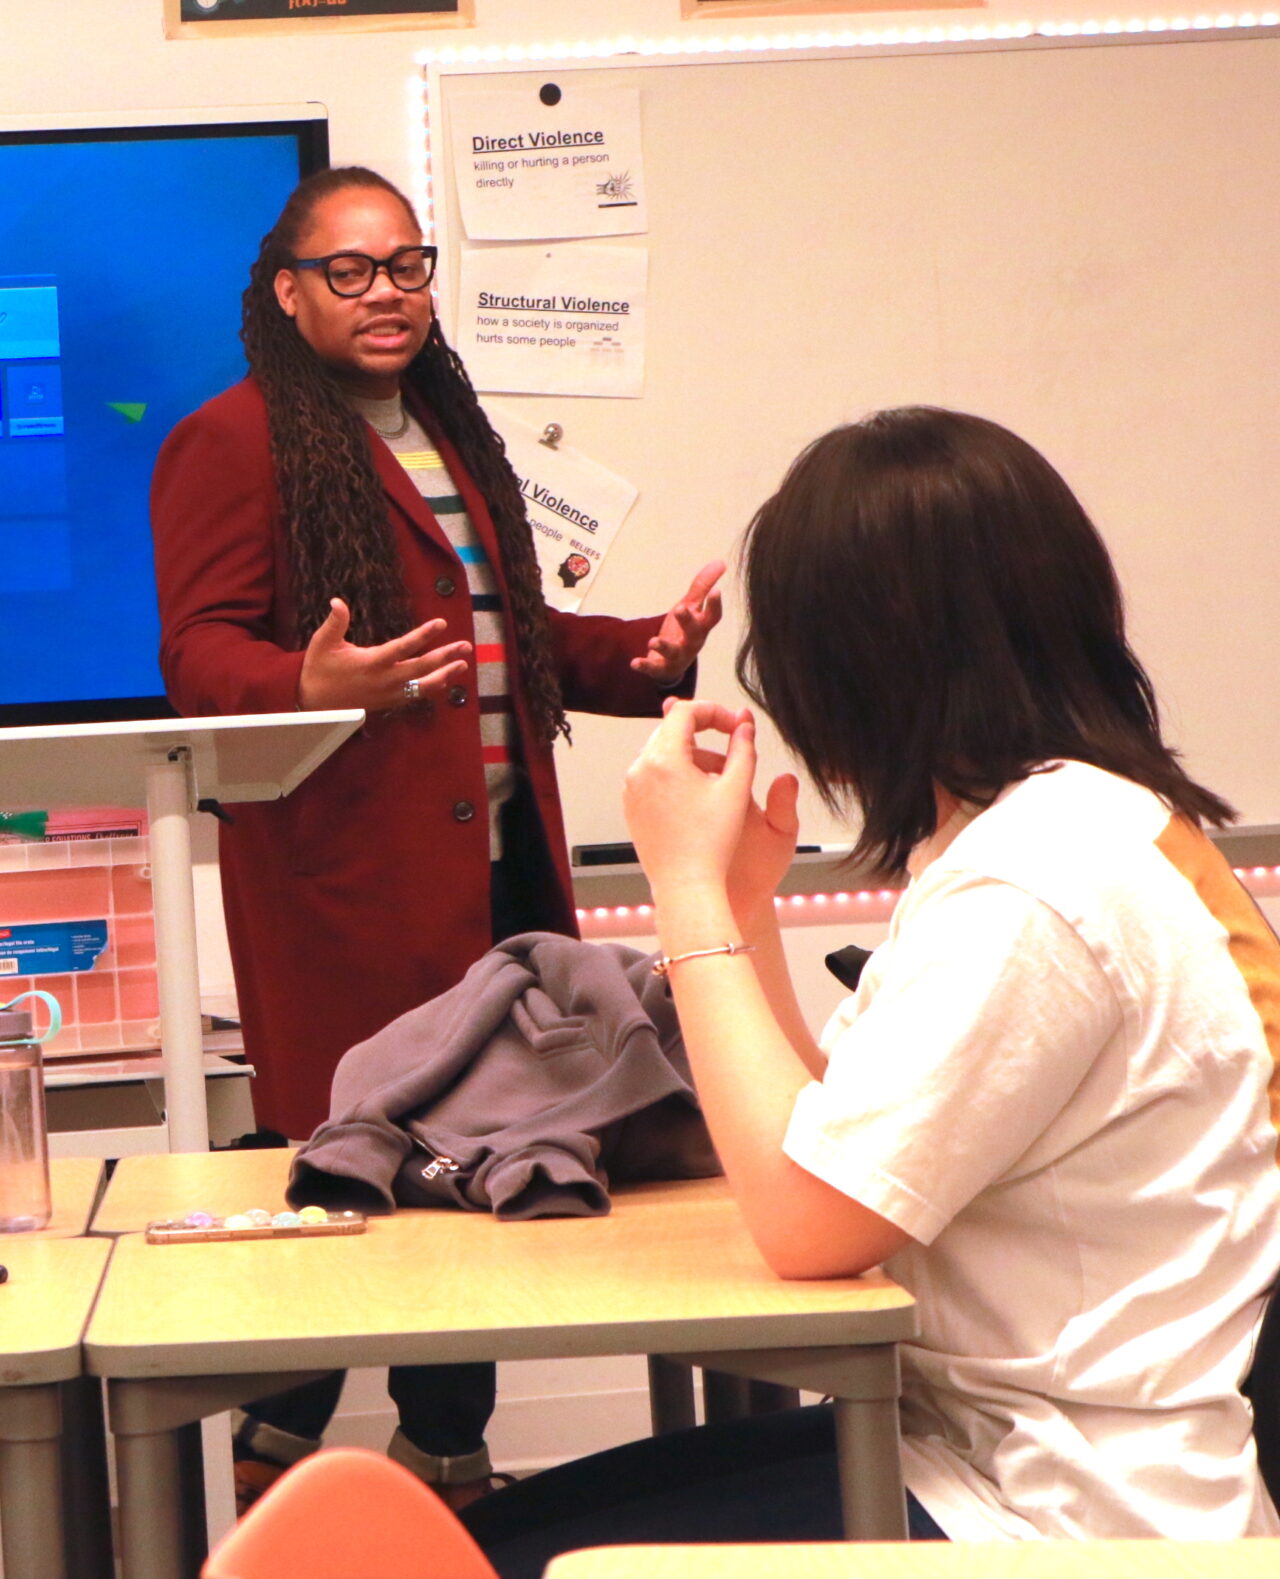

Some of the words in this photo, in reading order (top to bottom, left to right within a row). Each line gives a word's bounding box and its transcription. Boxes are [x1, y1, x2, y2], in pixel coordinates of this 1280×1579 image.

[472, 134, 524, 151] Direct
[528, 130, 604, 147] Violence
[473, 159, 505, 172] killing
[507, 159, 519, 169] or
[521, 156, 559, 169] hurting
[562, 156, 569, 165] a
[572, 153, 610, 167] person
[475, 176, 514, 189] directly
[478, 292, 556, 310] Structural
[560, 296, 630, 313] Violence
[476, 315, 500, 327] how
[502, 318, 509, 327] a
[512, 318, 551, 330] society
[553, 318, 563, 329] is
[565, 319, 619, 333] organized
[476, 333, 504, 344] hurts
[506, 335, 537, 346] some
[539, 335, 576, 348] people
[532, 483, 599, 532] Violence
[569, 538, 601, 561] BELIEFS
